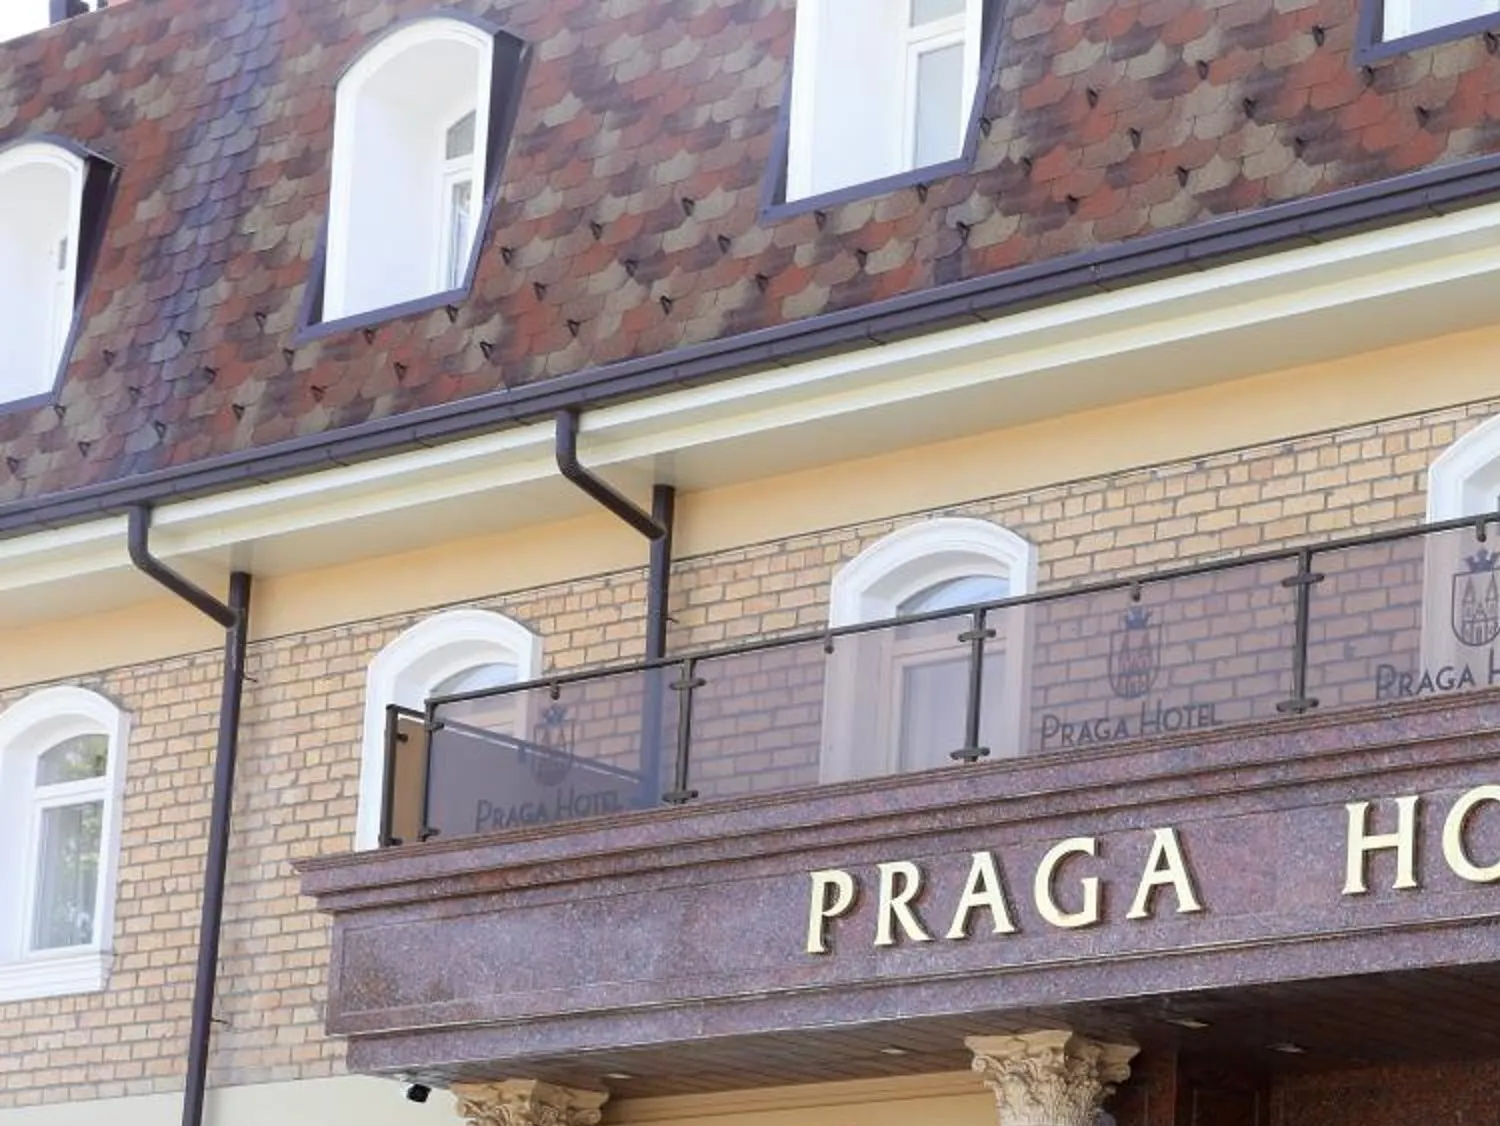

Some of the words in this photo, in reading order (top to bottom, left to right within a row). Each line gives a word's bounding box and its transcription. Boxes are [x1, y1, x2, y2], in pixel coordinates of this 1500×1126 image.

[1376, 664, 1476, 700] PRAGA
[1041, 714, 1129, 751] PRAGA
[1140, 700, 1222, 735] HOTEL
[804, 827, 1201, 953] PRAGA
